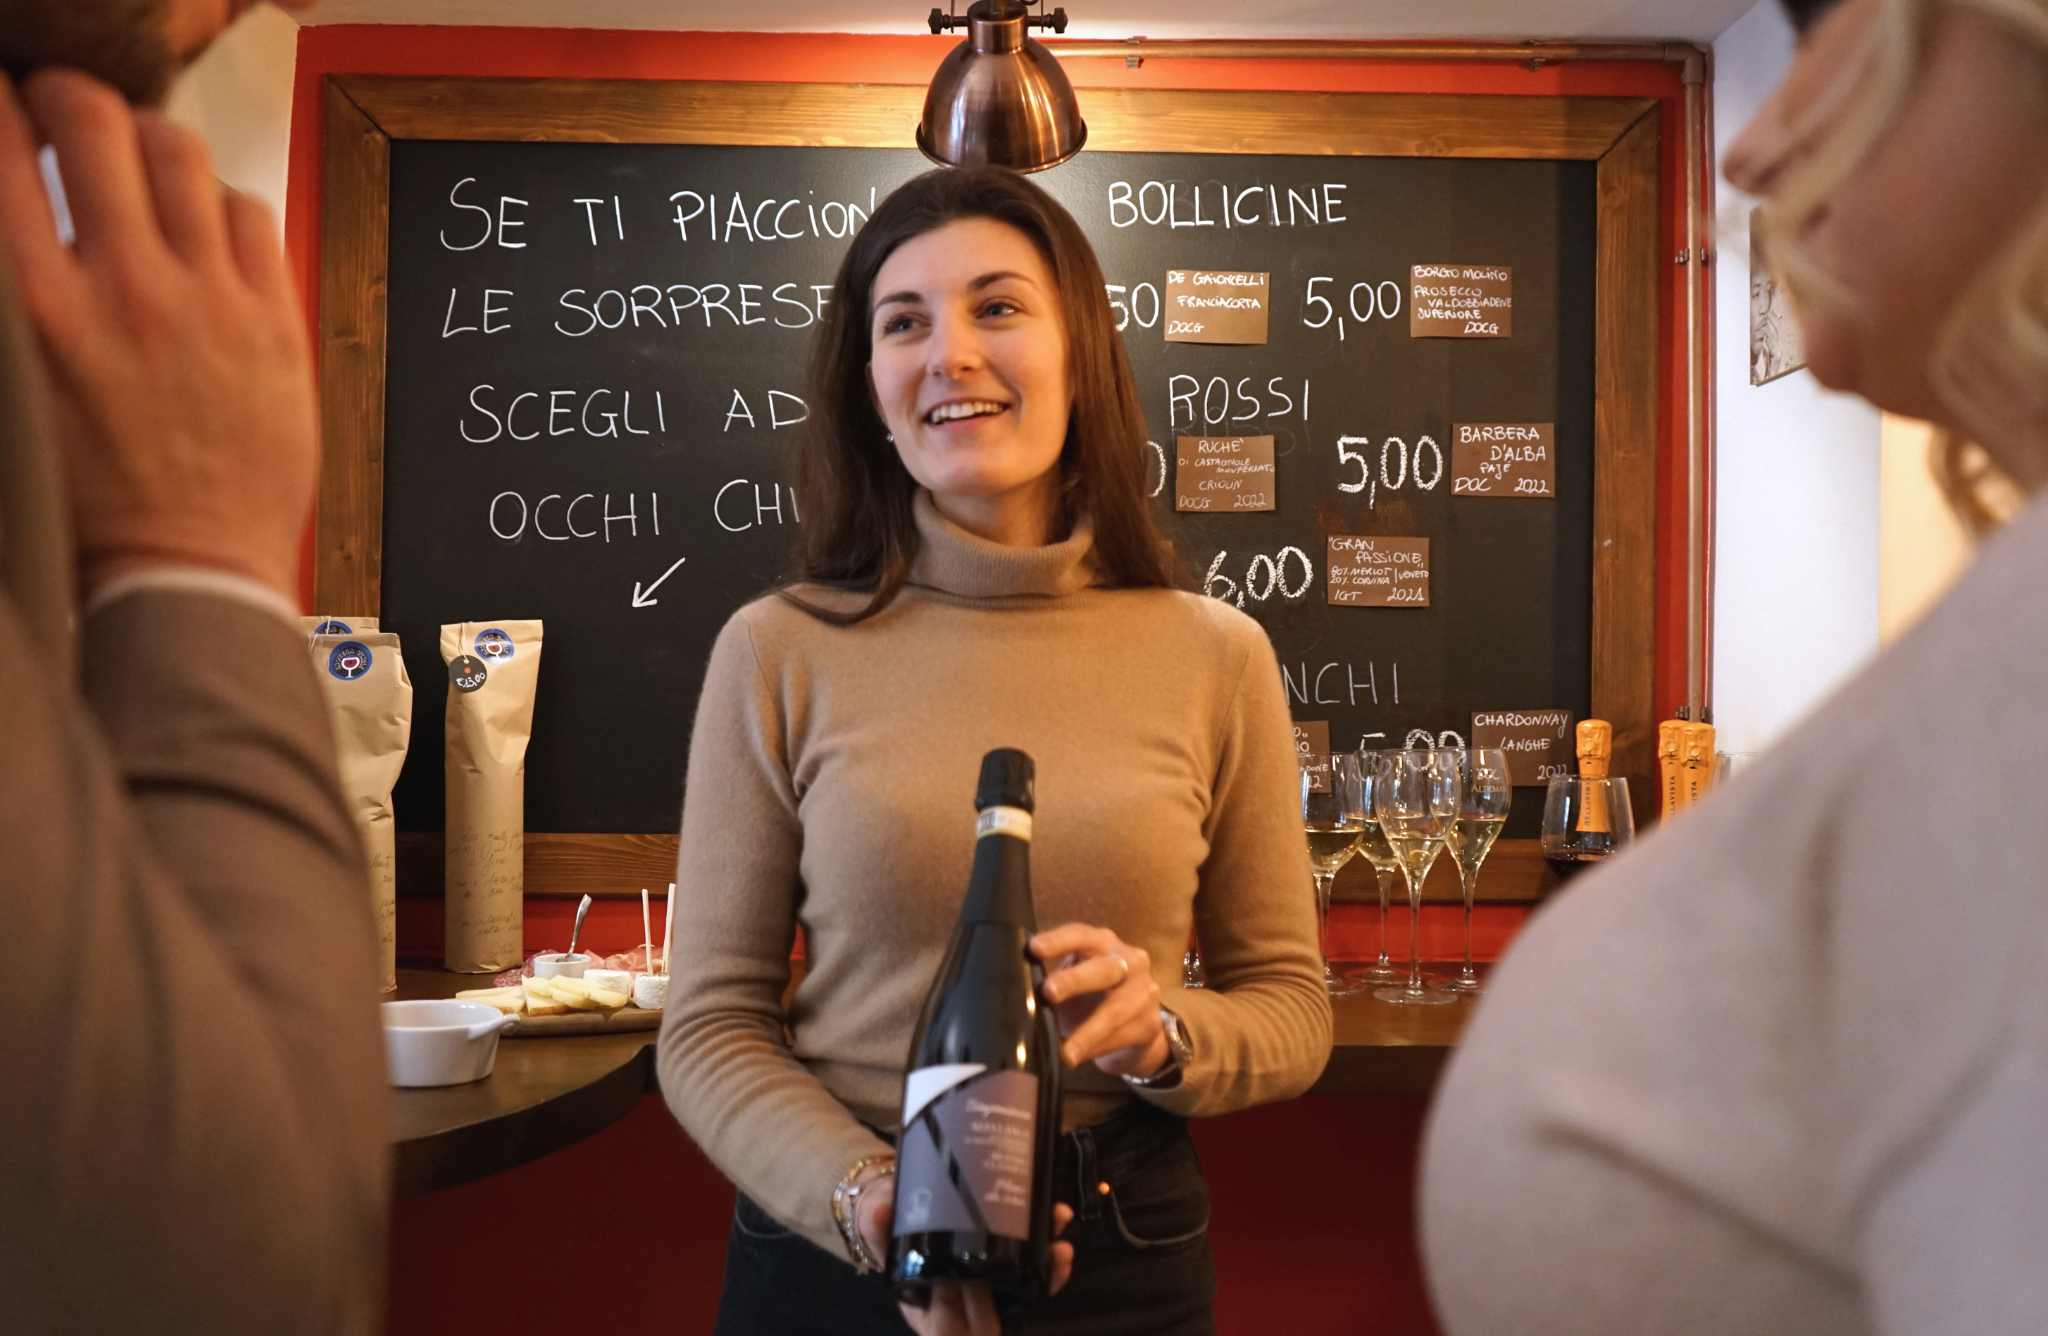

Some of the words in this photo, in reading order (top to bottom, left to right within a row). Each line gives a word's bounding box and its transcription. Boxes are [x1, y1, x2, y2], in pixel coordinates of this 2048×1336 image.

[440, 177, 529, 251] SE
[572, 194, 625, 246] TI
[1107, 181, 1348, 229] BOLLICINE
[1168, 271, 1186, 285] DE
[1413, 264, 1460, 279] BORGO
[1413, 285, 1483, 299] PROSECCO
[442, 287, 514, 338] LE
[554, 282, 835, 336] SORPRESE
[1304, 276, 1401, 341] 5,00
[1168, 320, 1205, 335] DOCG
[1463, 321, 1500, 335] DOCG
[1169, 374, 1309, 427] ROSSI
[460, 385, 666, 443] SCEGLI
[1460, 425, 1541, 444] BARBERA
[1194, 457, 1251, 467] CASTAGNOLE
[1490, 443, 1547, 462] D'ALBA
[1337, 434, 1444, 509] 5,00
[1454, 476, 1492, 493] DOC
[1513, 477, 1550, 495] 2022
[1179, 494, 1212, 510] DOCG
[1233, 492, 1268, 508] 2022
[488, 490, 660, 544] OCCHI
[713, 478, 801, 533] CHI
[1203, 545, 1315, 609] 6,00
[1350, 566, 1393, 577] MERLOT
[1334, 588, 1363, 602] IGT
[1386, 586, 1426, 603] 2021
[456, 672, 486, 688] €13,00
[1282, 661, 1399, 706] NCHI
[1474, 713, 1568, 738] CHARDONNAY
[1500, 736, 1551, 752] LANGHE
[1471, 783, 1508, 793] ALTEMAS
[1668, 775, 1676, 817] LLAVISTA
